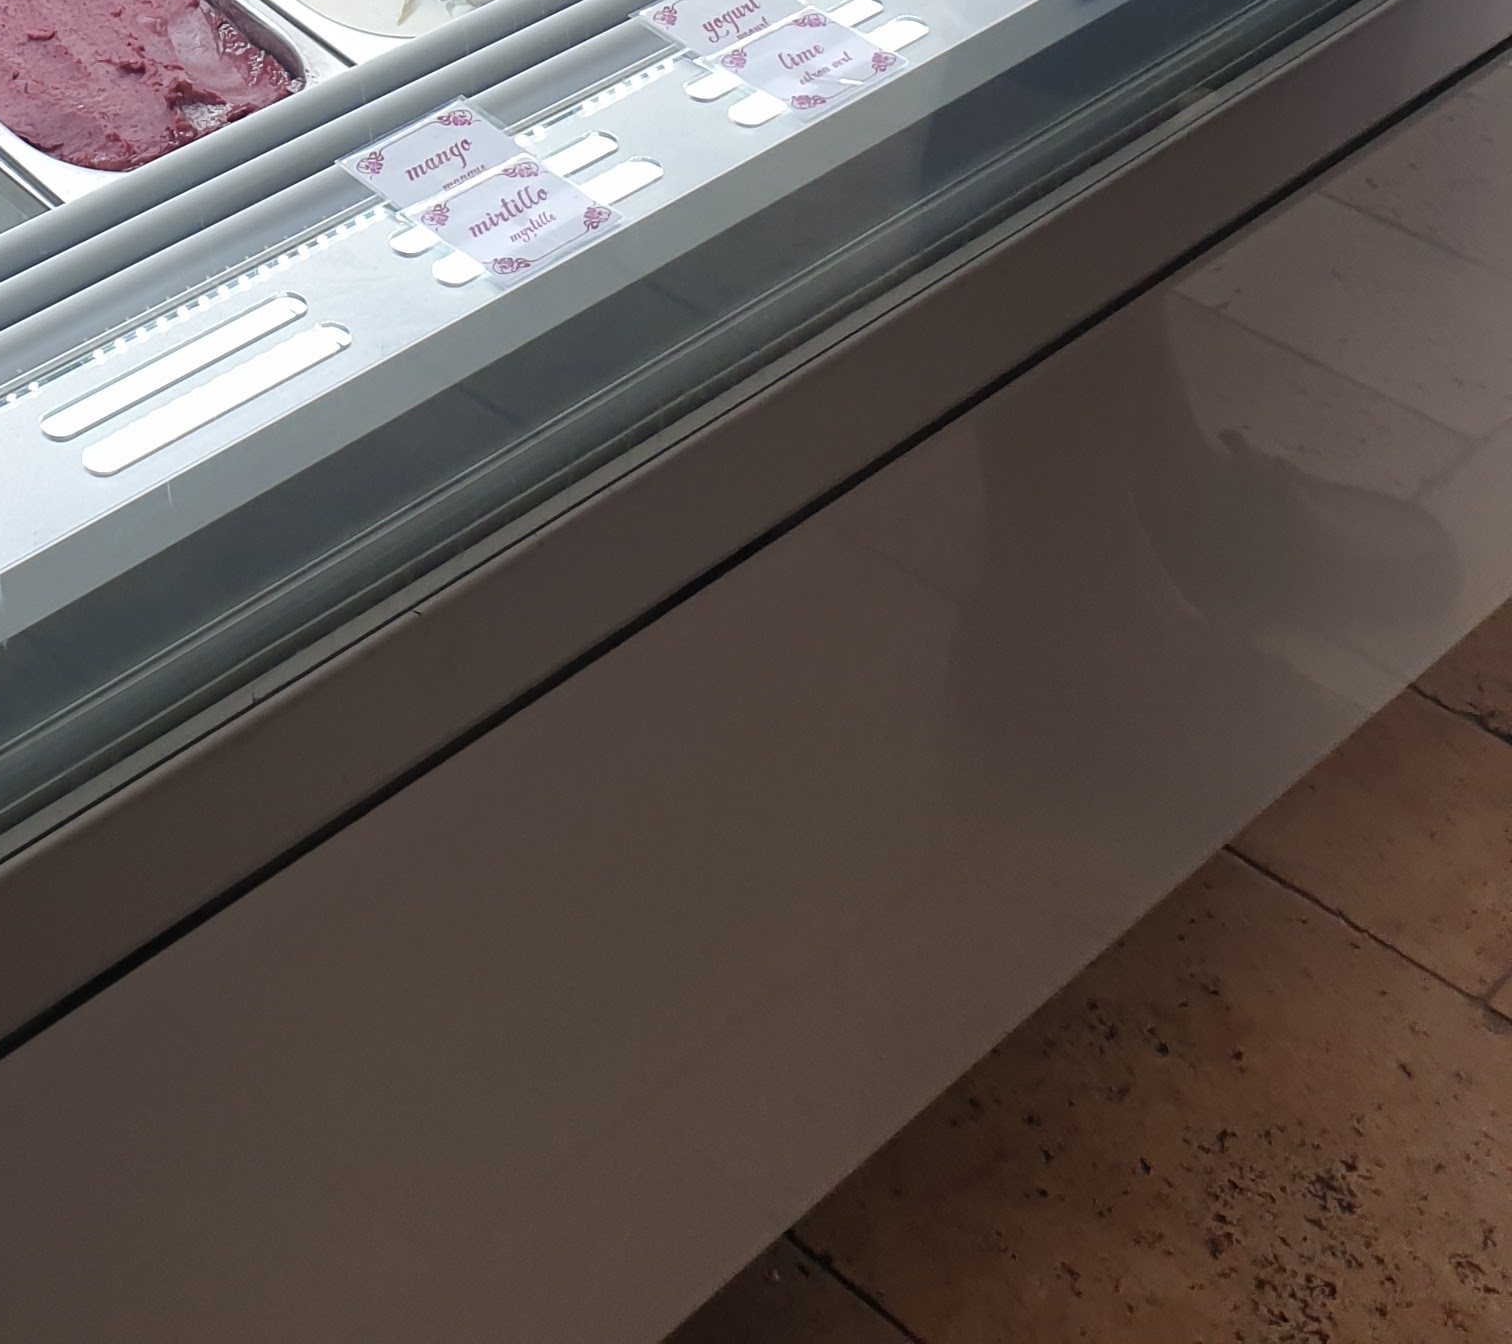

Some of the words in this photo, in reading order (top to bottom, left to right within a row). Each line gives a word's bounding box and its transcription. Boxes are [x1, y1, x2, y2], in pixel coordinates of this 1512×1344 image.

[778, 42, 824, 70] lime
[405, 138, 472, 181] mango
[468, 184, 550, 239] mirtillo
[509, 211, 558, 243] myrtille
